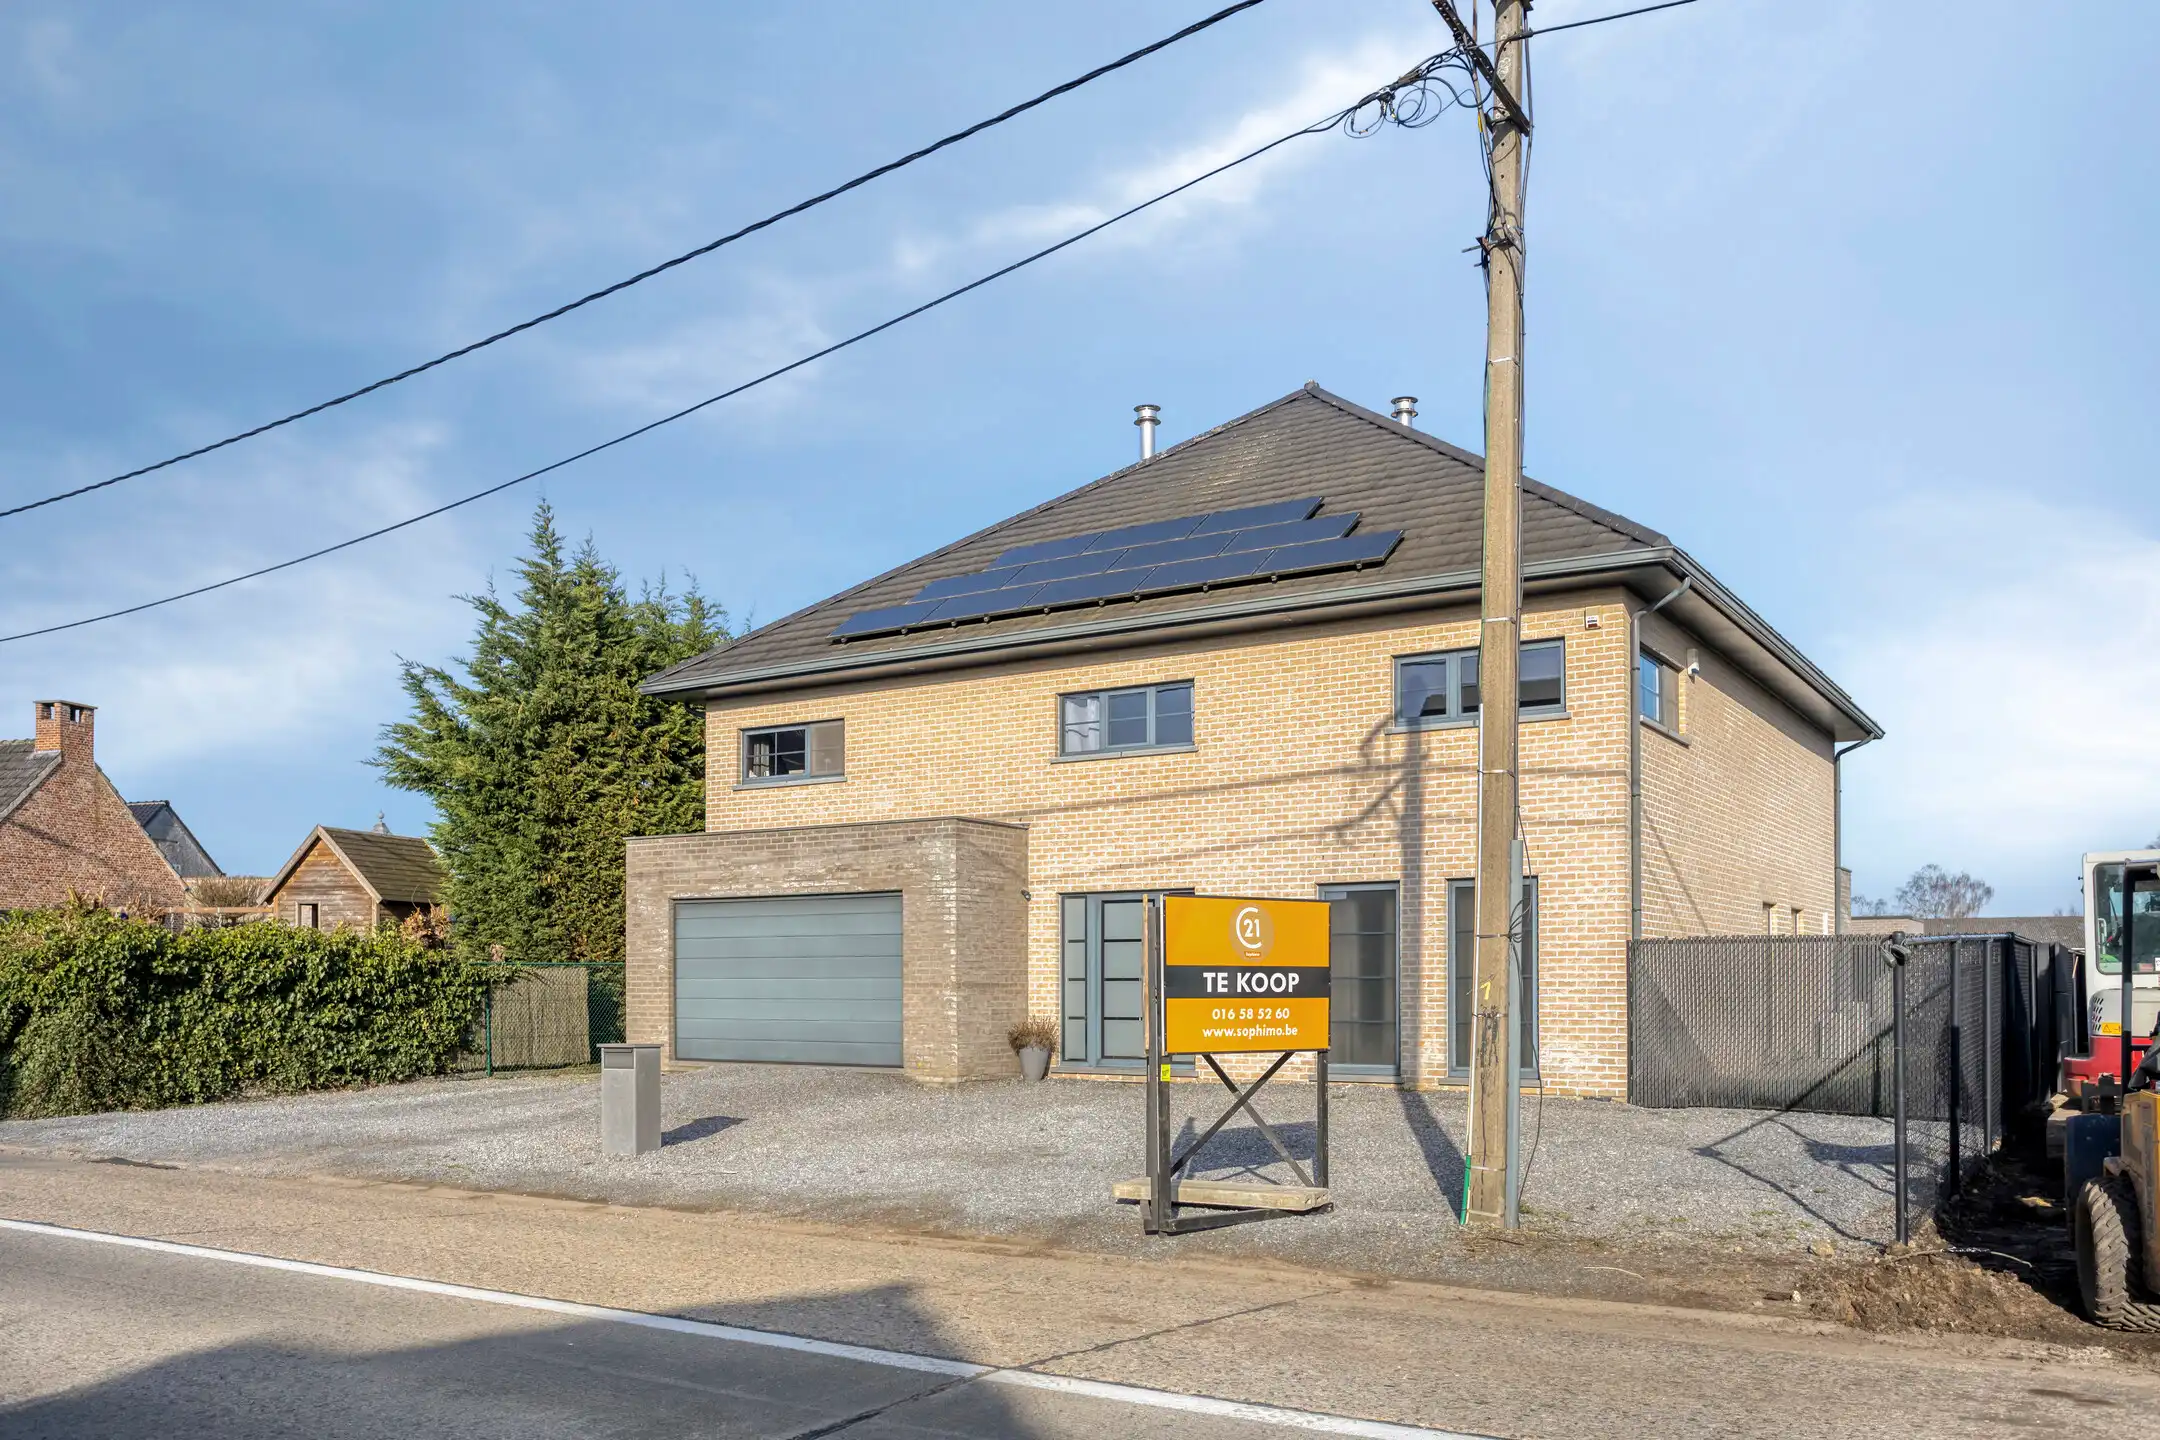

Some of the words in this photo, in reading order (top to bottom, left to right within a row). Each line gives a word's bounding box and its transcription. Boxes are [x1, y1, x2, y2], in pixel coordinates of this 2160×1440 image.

[1203, 972, 1228, 993] TE
[1236, 972, 1300, 993] KOOP
[1212, 1008, 1236, 1020] 016
[1239, 1008, 1254, 1020] 58
[1257, 1008, 1272, 1020] 52
[1275, 1007, 1290, 1019] 60
[1202, 1023, 1298, 1040] www.sophimo.be
